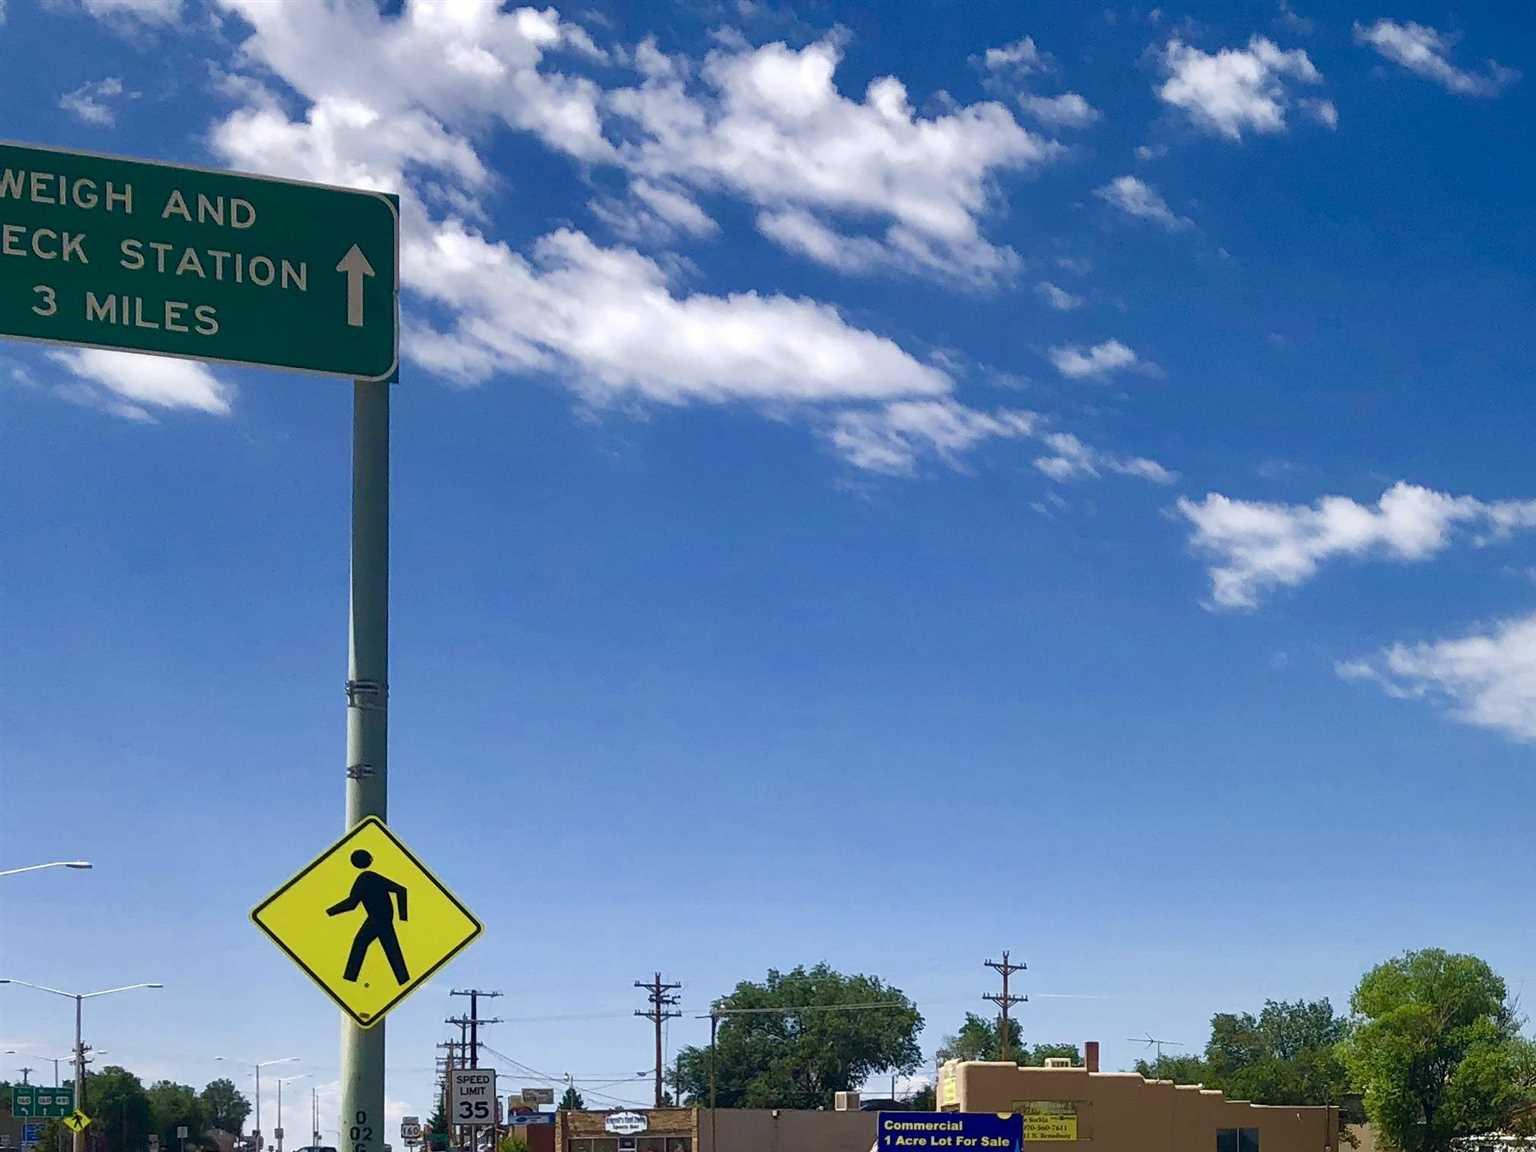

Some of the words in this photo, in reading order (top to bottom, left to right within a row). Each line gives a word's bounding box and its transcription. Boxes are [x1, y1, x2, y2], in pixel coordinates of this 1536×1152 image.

[0, 169, 132, 213] WEIGH
[161, 190, 257, 229] AND
[119, 239, 307, 292] STATION
[31, 285, 57, 316] 3
[86, 291, 219, 335] MILES
[456, 1075, 490, 1085] SPEED
[459, 1086, 486, 1096] LIMIT
[459, 1101, 490, 1119] 35
[403, 1127, 418, 1137] 160
[884, 1120, 963, 1131] Commercial
[350, 1126, 373, 1141] 02
[884, 1136, 891, 1146] 1
[896, 1136, 927, 1146] Acre
[931, 1136, 952, 1146] Lot
[956, 1136, 977, 1147] For
[981, 1136, 1010, 1147] Sale
